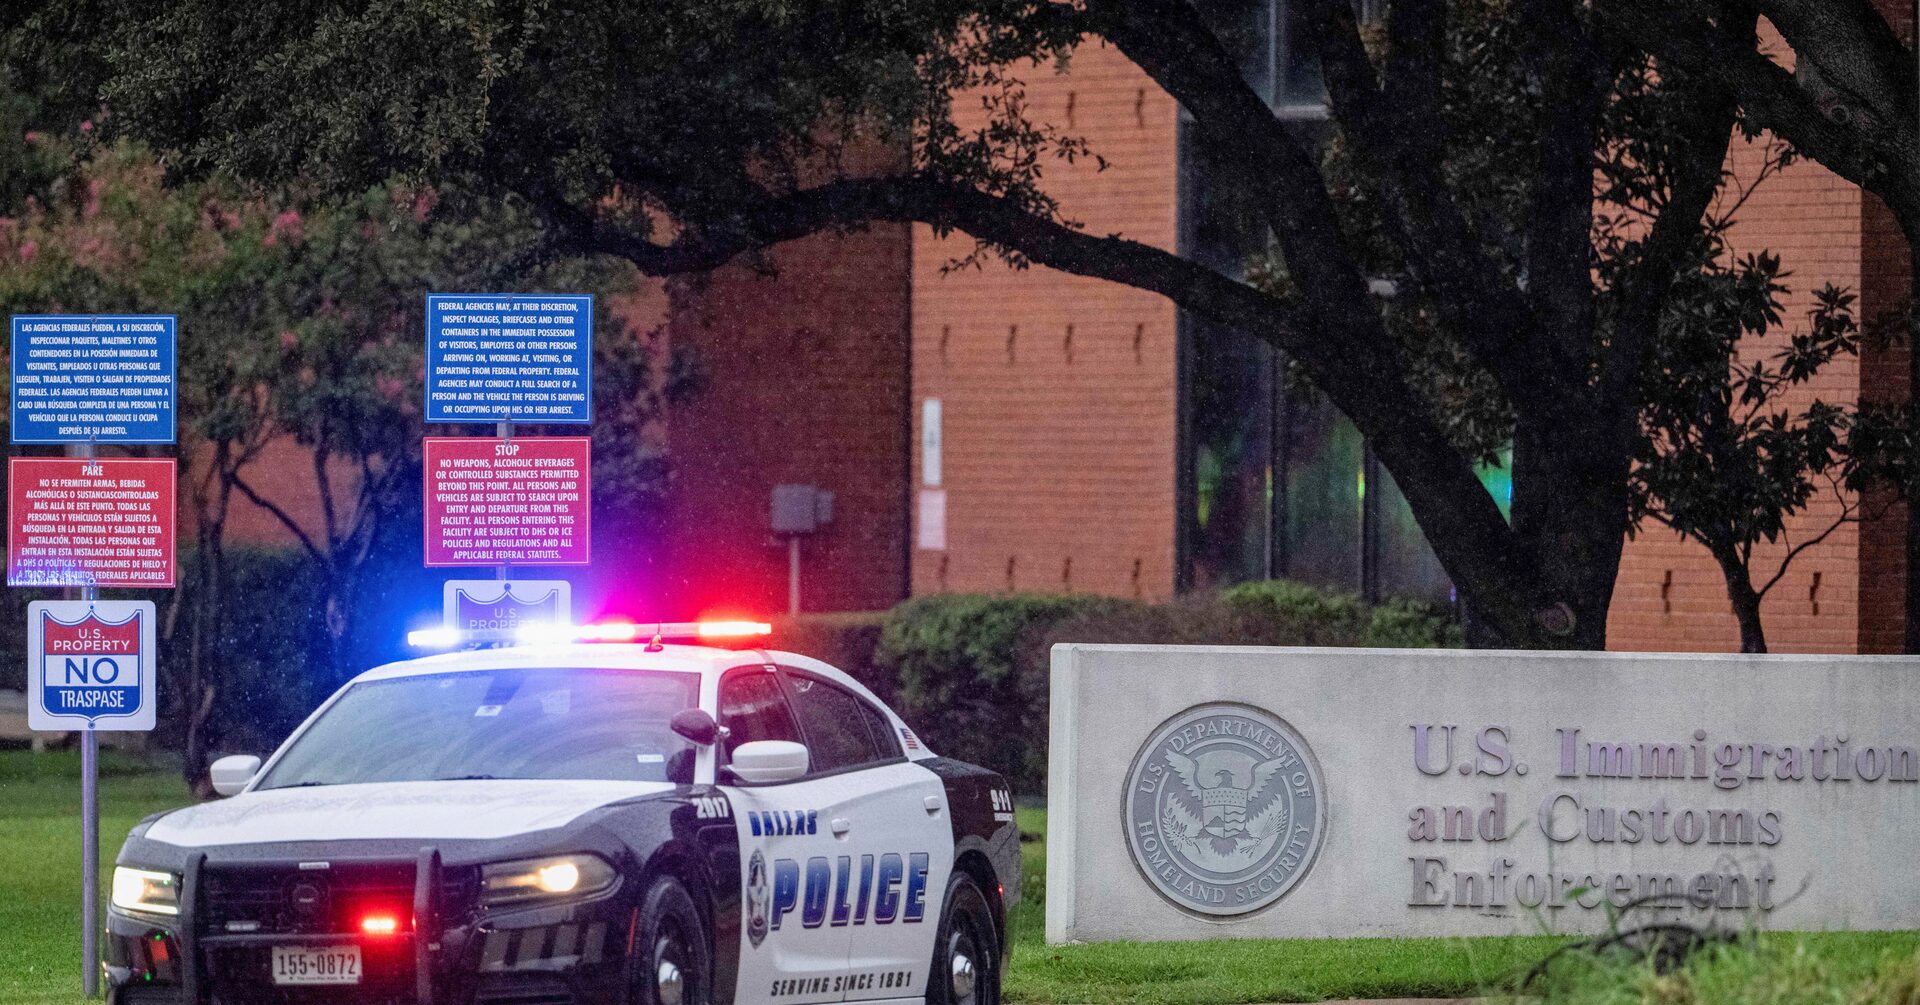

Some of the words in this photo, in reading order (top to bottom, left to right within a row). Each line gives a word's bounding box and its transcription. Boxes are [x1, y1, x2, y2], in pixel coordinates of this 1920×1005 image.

[438, 302, 464, 310] FEDERAL
[465, 303, 494, 311] AGENCIES
[496, 303, 512, 311] MAY,
[541, 303, 578, 312] DISCRETION,
[468, 315, 501, 324] PACKAGES,
[503, 316, 537, 324] BRIEFCASES
[22, 324, 32, 332] LAS
[33, 324, 60, 332] AGENCIAS
[61, 324, 90, 332] FEDERALES
[92, 323, 115, 333] PUEDEN,
[122, 324, 130, 332] SU
[442, 328, 479, 336] CONTAINERS
[538, 329, 575, 337] POSSESSION
[30, 337, 70, 345] INSPECCIONAR
[72, 337, 100, 345] PAQUETES,
[102, 337, 131, 345] MALETINES
[138, 336, 157, 345] OTROS
[449, 341, 478, 350] VISITORS,
[549, 342, 577, 350] PERSONS
[443, 354, 474, 362] ARRIVING
[476, 354, 488, 363] ON,
[522, 354, 530, 363] AT,
[532, 354, 561, 363] VISITING,
[562, 354, 572, 363] OR
[436, 367, 470, 375] DEPARTING
[554, 367, 579, 375] FEDERAL
[485, 380, 514, 388] CONDUCT
[521, 380, 535, 388] FULL
[537, 380, 560, 388] SEARCH
[562, 380, 570, 388] OF
[432, 392, 456, 400] PERSON
[486, 393, 510, 401] VEHICLE
[492, 406, 510, 414] UPON
[549, 406, 573, 414] ARREST.
[84, 427, 90, 435] DE
[92, 427, 100, 435] SU
[101, 426, 127, 435] ARRESTO.
[495, 444, 520, 456] STOP
[440, 459, 451, 468] NO
[453, 459, 491, 469] WEAPONS,
[493, 459, 533, 467] ALCOHOLIC
[534, 458, 574, 467] BEVERAGES
[82, 466, 103, 476] PARE
[436, 471, 446, 479] OR
[449, 470, 493, 479] CONTROLLED
[495, 470, 538, 479] SUBSTANCES
[540, 470, 579, 478] PERMITTED
[39, 479, 49, 487] NO
[51, 479, 59, 487] SE
[60, 479, 91, 487] PERMITEN
[93, 479, 118, 489] ARMAS,
[120, 479, 145, 488] BEBIDAS
[438, 482, 466, 491] BEYOND
[469, 482, 484, 490] THIS
[486, 482, 510, 490] POINT.
[512, 482, 524, 490] ALL
[526, 481, 559, 490] PERSONS
[561, 481, 576, 490] AND
[70, 490, 74, 499] O
[436, 493, 468, 502] VEHICLES
[470, 493, 484, 502] ARE
[486, 493, 515, 502] SUBJECT
[516, 493, 526, 501] TO
[528, 493, 555, 501] SEARCH
[557, 493, 578, 501] UPON
[446, 505, 468, 513] ENTRY
[470, 505, 486, 513] AND
[488, 504, 528, 513] DEPARTURE
[530, 504, 551, 513] FROM
[553, 504, 568, 512] THIS
[440, 516, 471, 525] FACILITY.
[474, 516, 486, 525] ALL
[487, 516, 520, 524] PERSONS
[522, 516, 556, 524] ENTERING
[558, 516, 574, 524] THIS
[442, 528, 471, 536] FACILITY
[474, 528, 487, 536] ARE
[489, 527, 518, 536] SUBJECT
[520, 527, 530, 536] TO
[532, 527, 546, 536] DHS
[548, 527, 559, 536] OR
[562, 527, 572, 536] ICE
[442, 539, 473, 548] POLICIES
[474, 539, 490, 548] AND
[492, 539, 541, 547] REGULATIONS
[542, 539, 558, 547] AND
[560, 539, 572, 547] ALL
[453, 551, 493, 559] APPLICABLE
[495, 550, 525, 559] FEDERAL
[527, 550, 562, 559] STATUTES.
[78, 629, 105, 639] U.S.
[54, 640, 130, 651] PROPERTY
[65, 657, 119, 684] NO
[60, 690, 124, 707] TRASPASE
[1139, 762, 1166, 794] U.S.
[1169, 719, 1300, 770] DEPARTMENT
[1292, 771, 1312, 798] OF
[1408, 724, 1528, 777] U.S.
[1555, 727, 1918, 790] Immigration
[692, 797, 729, 818] 2017
[748, 809, 817, 836] DALLAS
[1407, 791, 1508, 841] and
[1538, 794, 1783, 845] Customs
[1138, 820, 1225, 903] HOMELAND
[1235, 823, 1309, 903] SECURITY
[1407, 856, 1776, 910] Enforcement
[770, 852, 929, 931] POLICE
[771, 977, 829, 996] SERVING
[834, 973, 874, 992] SINCE
[879, 971, 912, 988] 1881
